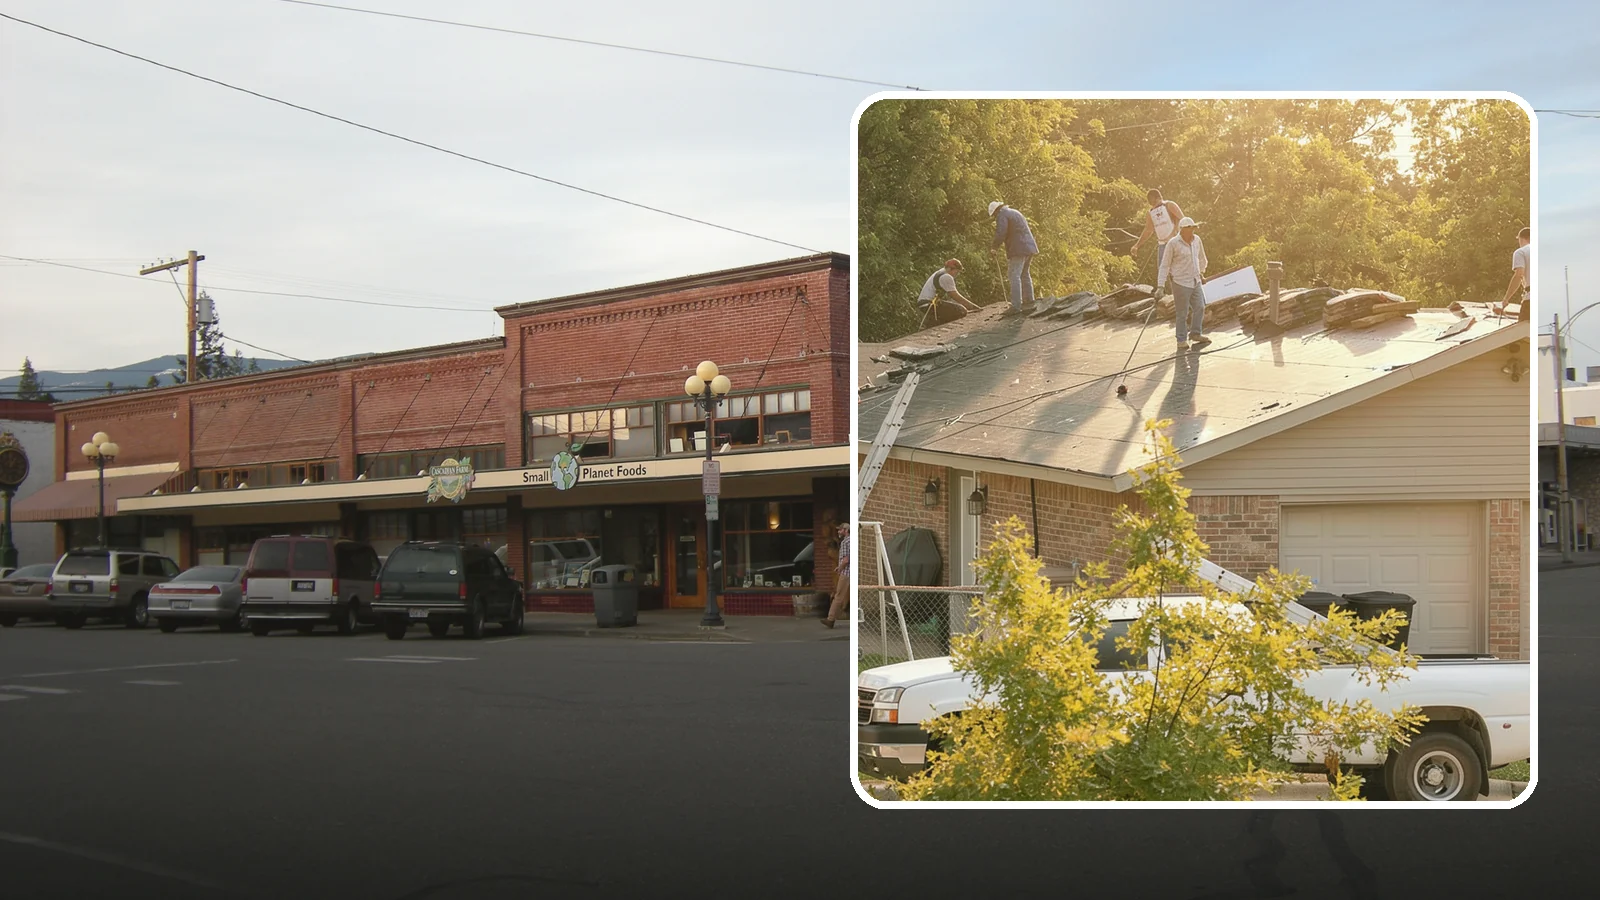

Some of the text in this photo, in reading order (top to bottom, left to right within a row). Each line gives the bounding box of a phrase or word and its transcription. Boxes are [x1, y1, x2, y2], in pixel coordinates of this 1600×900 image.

[523, 464, 647, 483] Small Planet Foods
